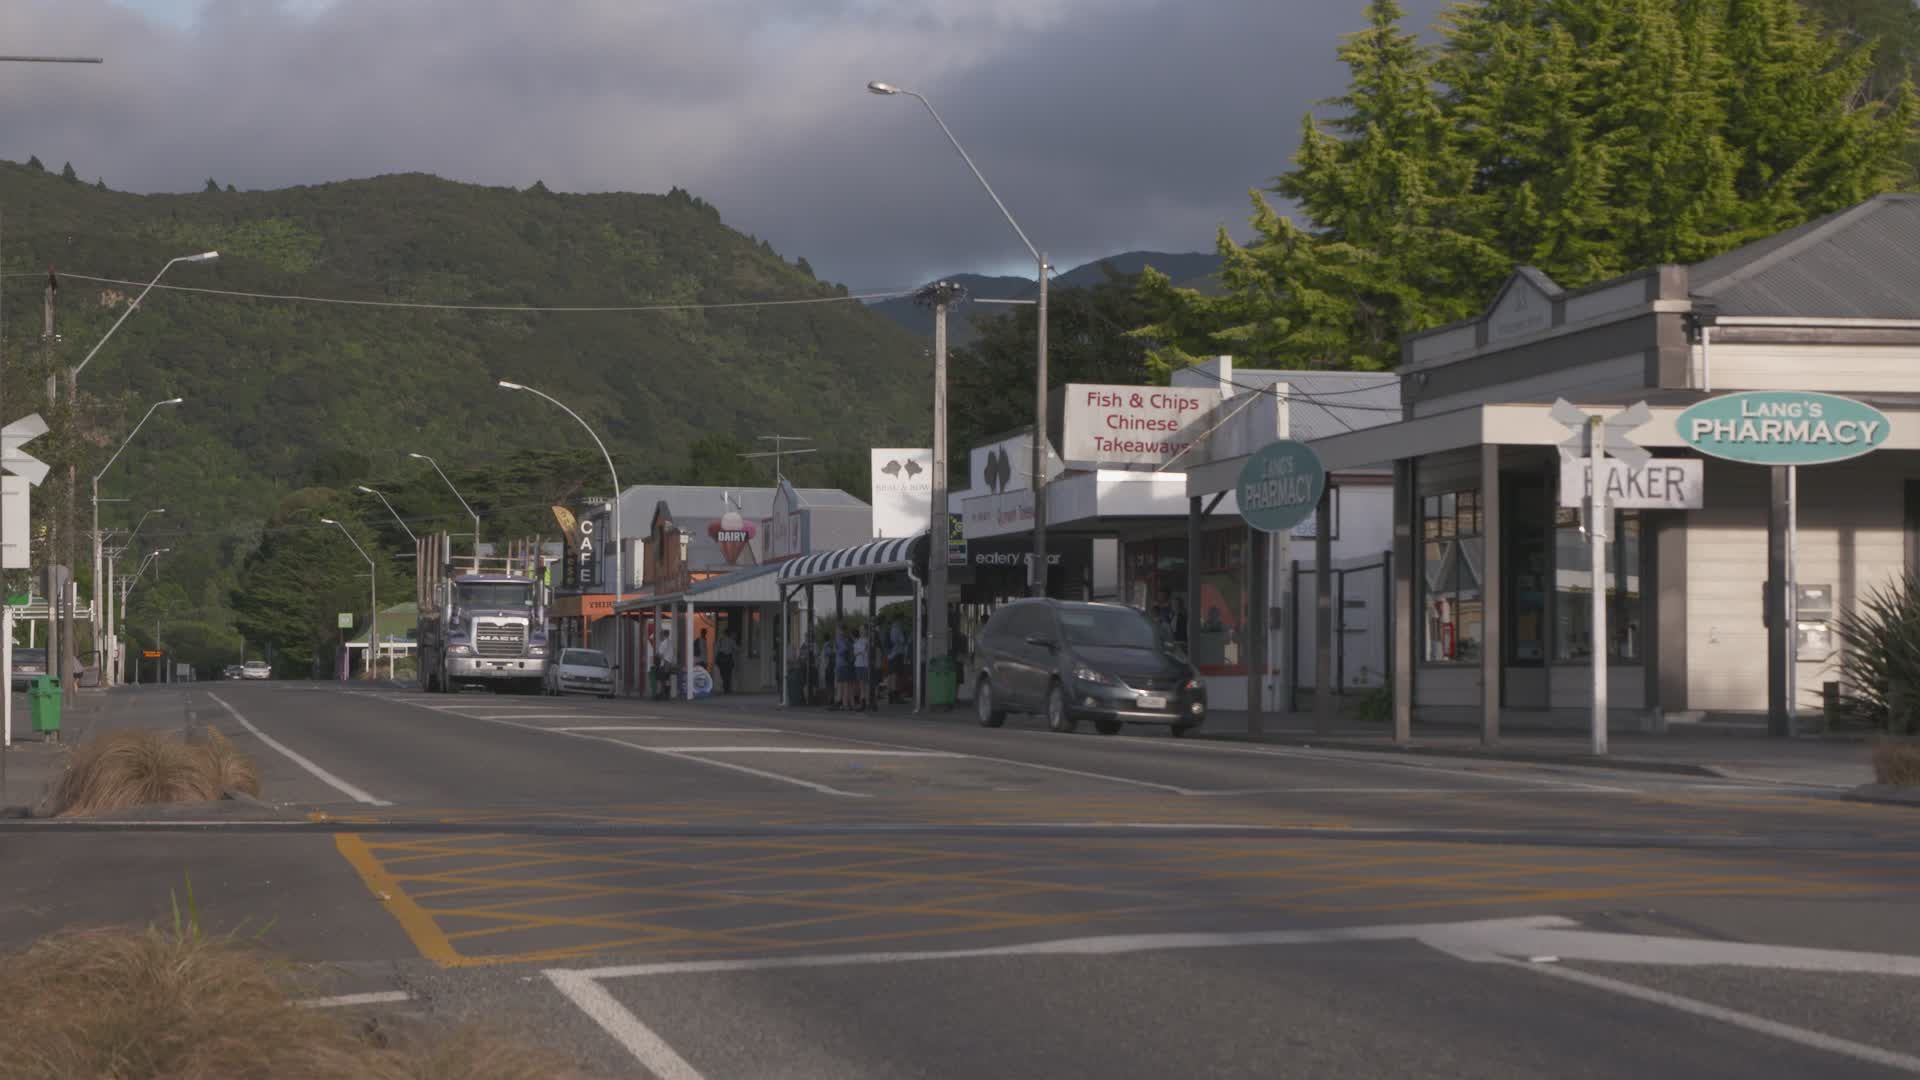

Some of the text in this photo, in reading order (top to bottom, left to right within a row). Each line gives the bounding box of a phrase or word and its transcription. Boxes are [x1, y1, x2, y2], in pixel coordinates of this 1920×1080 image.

[1087, 392, 1200, 413] Fish & Chips
[1106, 414, 1178, 432] Chinese
[1691, 418, 1881, 444] PHARMACY
[1094, 436, 1191, 456] Takeaways
[1245, 472, 1313, 507] PHARMACY
[718, 531, 746, 542] DAIRY
[580, 520, 593, 582] CAFE
[976, 552, 1021, 567] eatery
